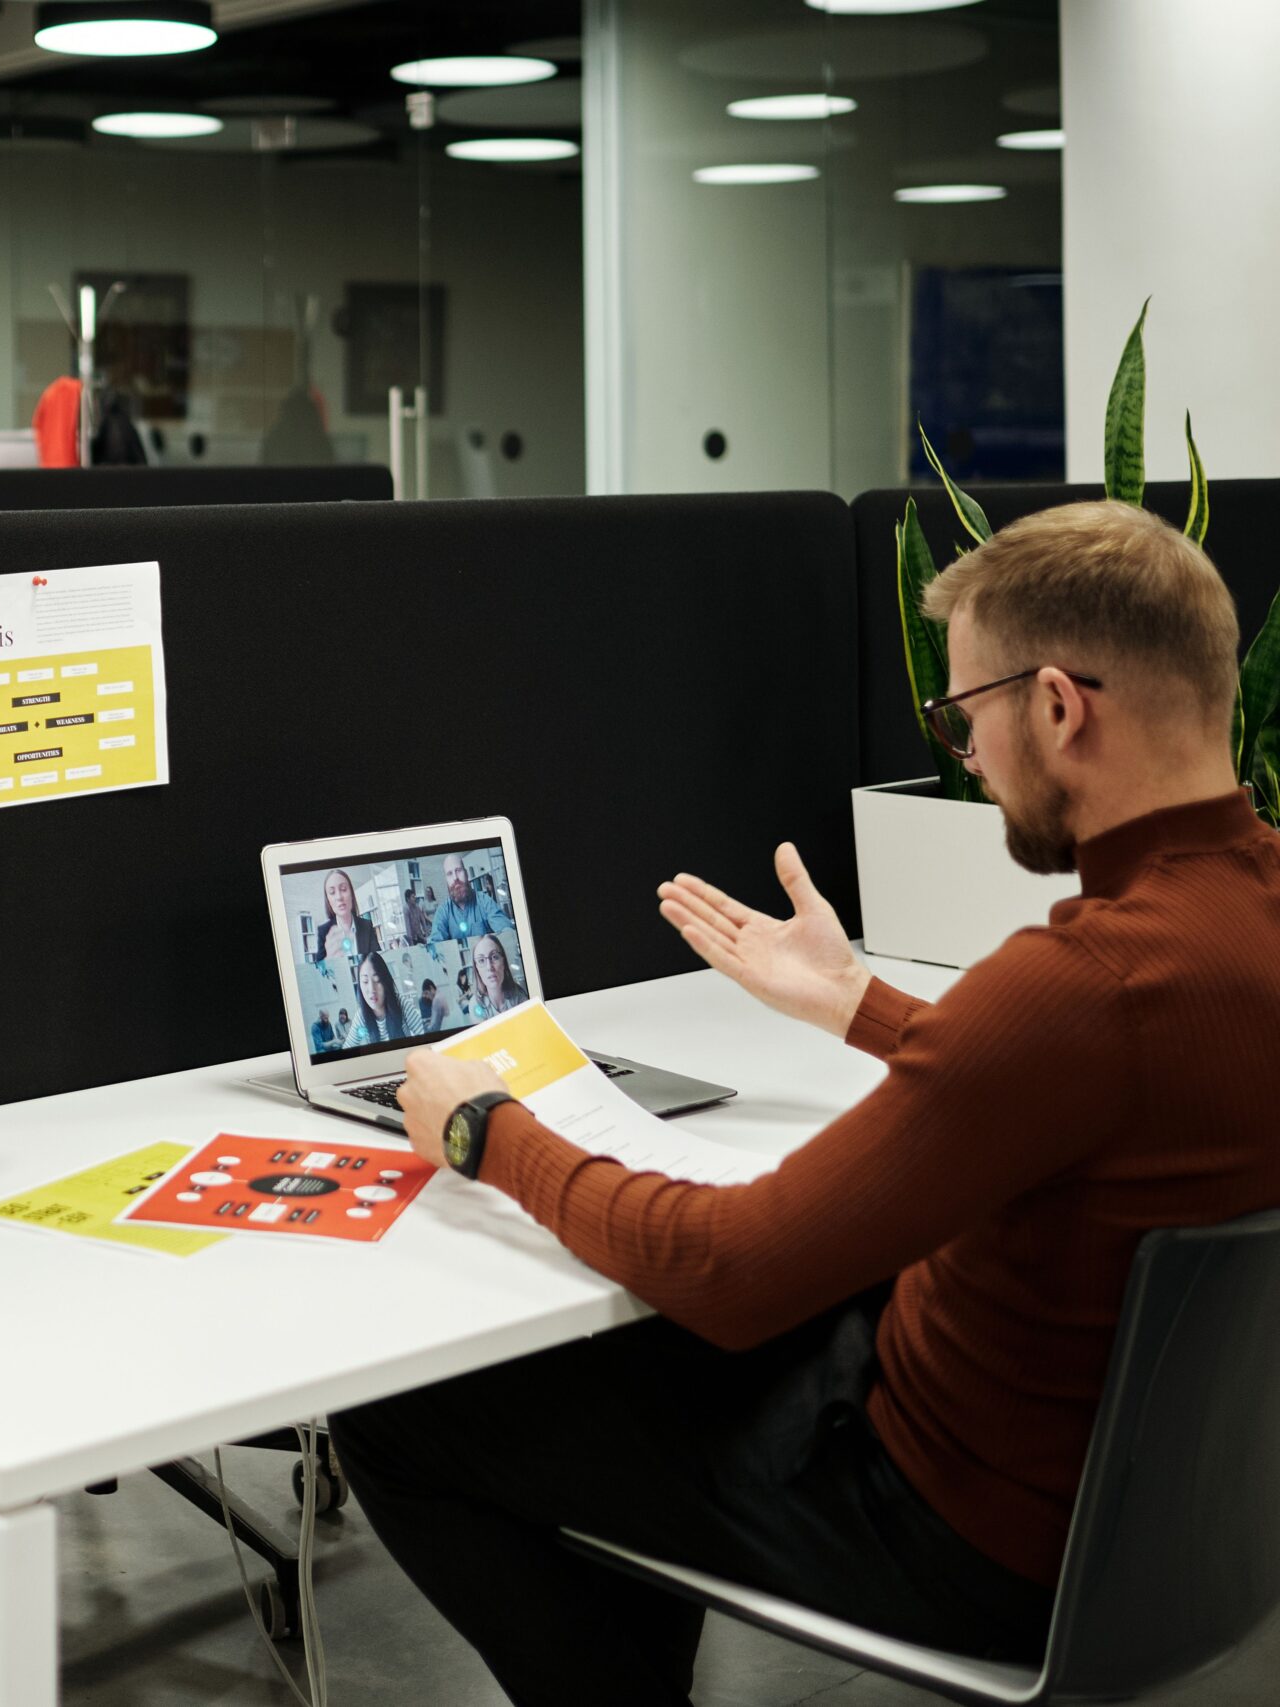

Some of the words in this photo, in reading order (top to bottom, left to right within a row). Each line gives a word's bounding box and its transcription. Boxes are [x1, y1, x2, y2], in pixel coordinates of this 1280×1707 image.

[21, 695, 51, 705] STRENGTH
[56, 717, 85, 726] WEAKNESS
[16, 749, 60, 761] OPPORTUNITIES
